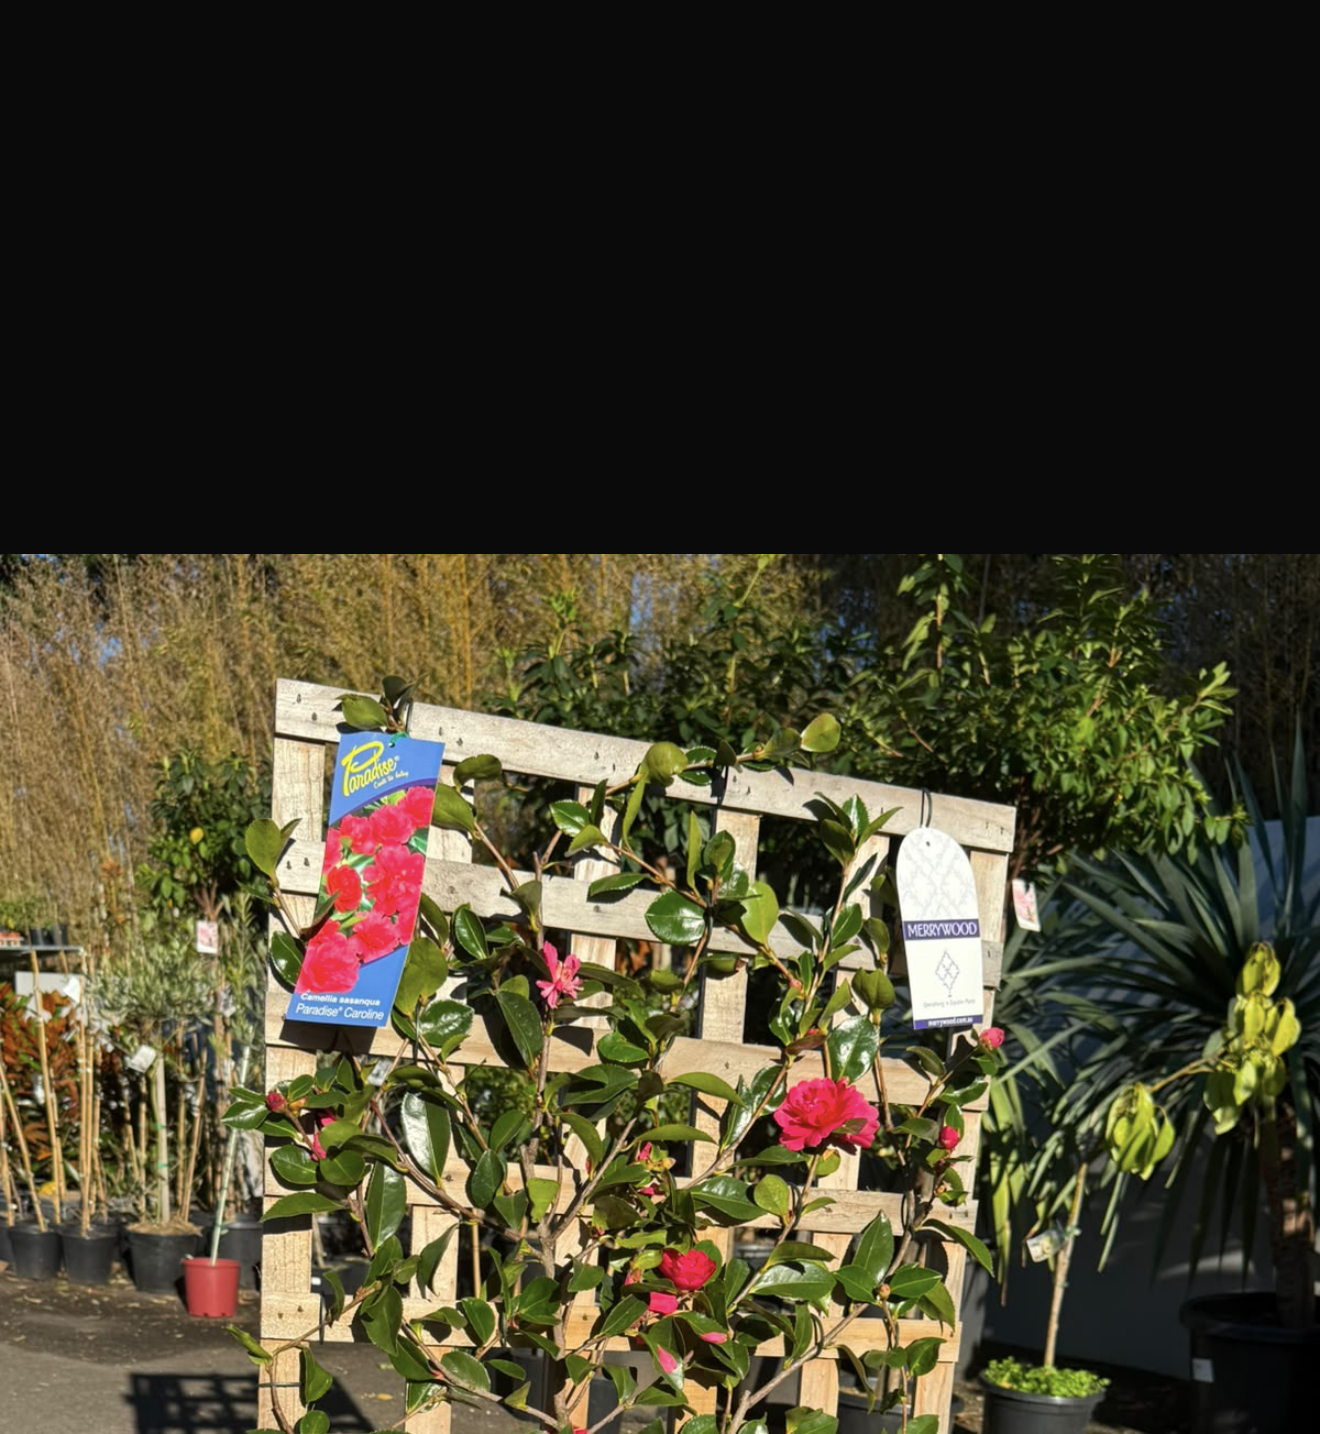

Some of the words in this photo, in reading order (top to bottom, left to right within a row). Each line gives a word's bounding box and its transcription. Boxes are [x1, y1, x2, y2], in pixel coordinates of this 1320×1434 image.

[907, 921, 978, 937] MERRYWOOD
[300, 992, 338, 1003] Camellia
[339, 996, 380, 1006] sasanqua
[343, 1006, 385, 1020] Caroline
